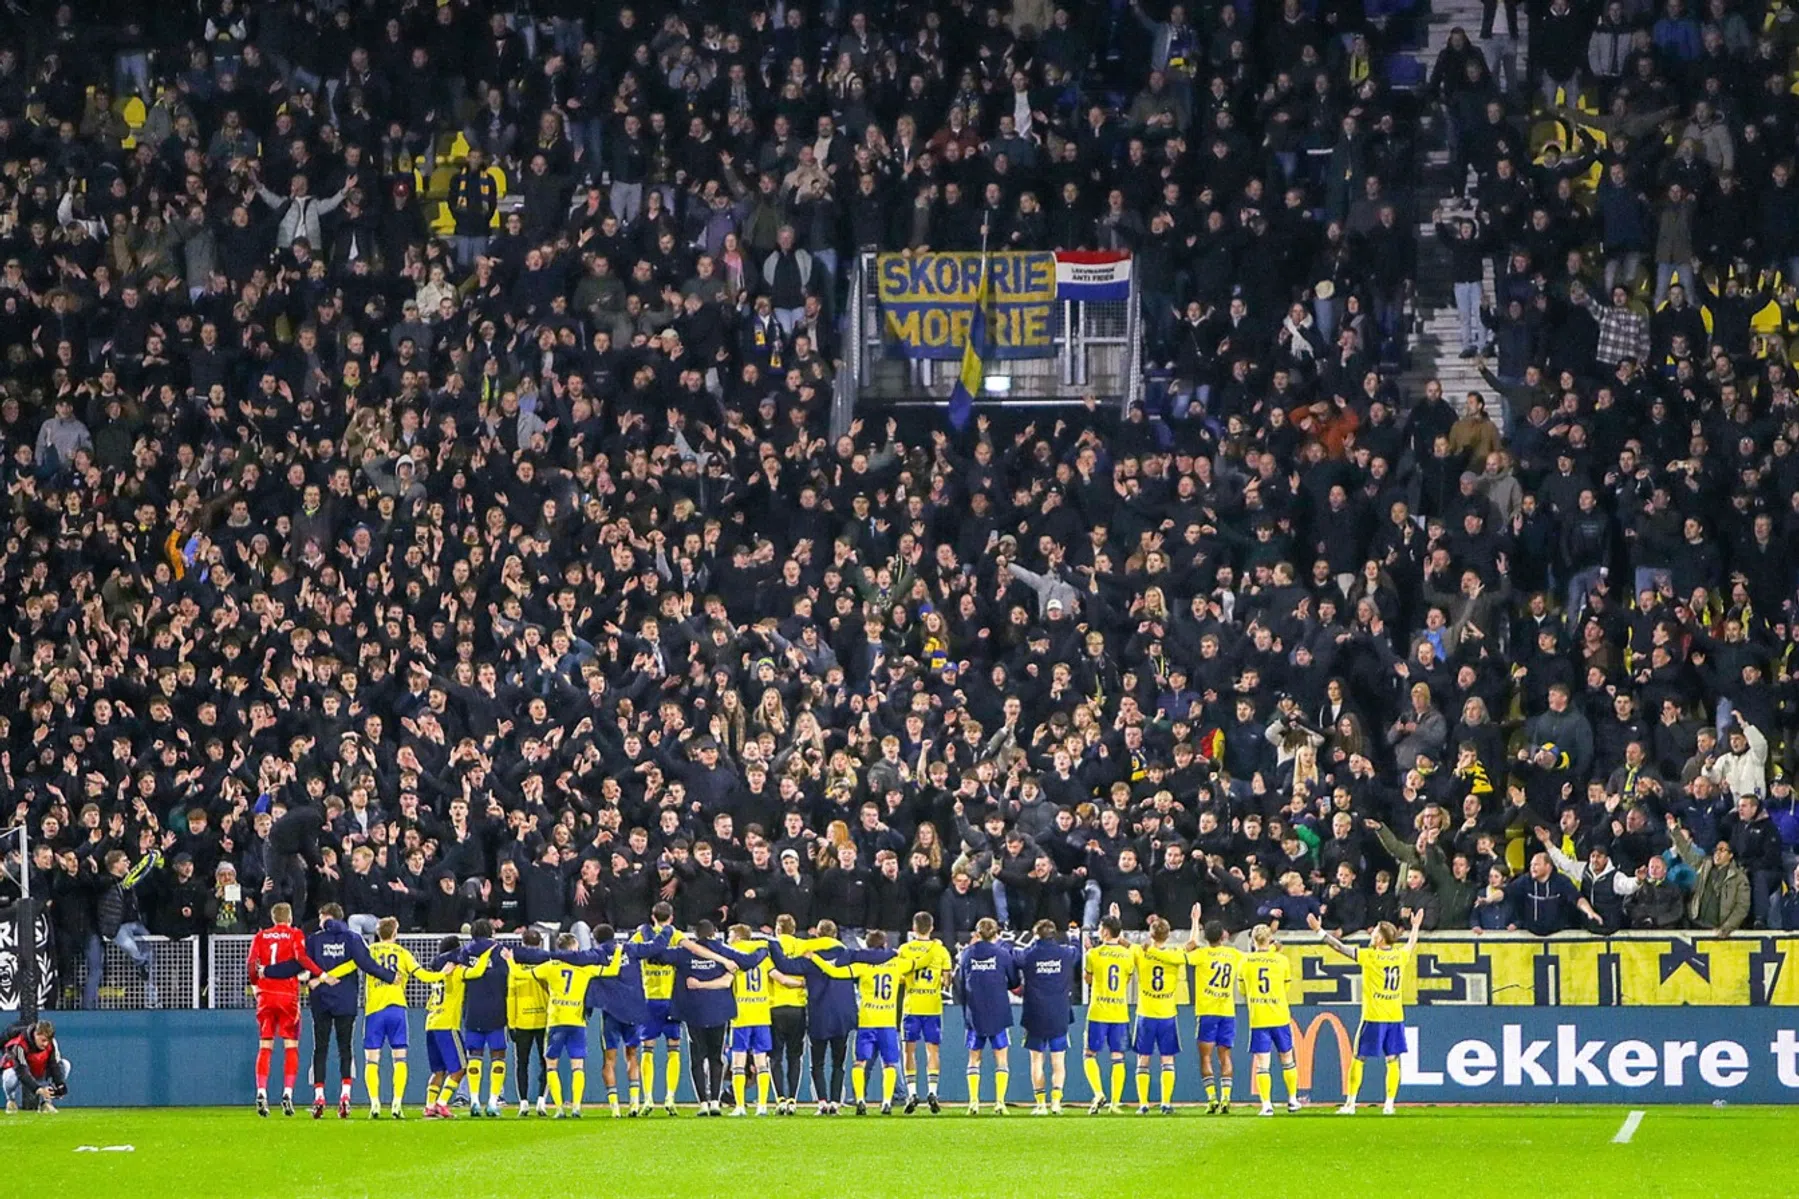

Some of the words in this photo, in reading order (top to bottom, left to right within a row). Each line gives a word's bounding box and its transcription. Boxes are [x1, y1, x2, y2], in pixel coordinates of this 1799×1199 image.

[884, 253, 1051, 295] SKORRIE
[270, 942, 279, 966] 1
[561, 969, 573, 996] 7
[746, 966, 761, 992] 19
[873, 973, 892, 1000] 16
[914, 966, 934, 984] 14
[1108, 964, 1119, 992] 6
[1152, 965, 1164, 992] 8
[1209, 960, 1232, 988] 28
[1258, 967, 1270, 994] 5
[1383, 965, 1400, 991] 10
[1400, 1024, 1749, 1088] Lekkere
